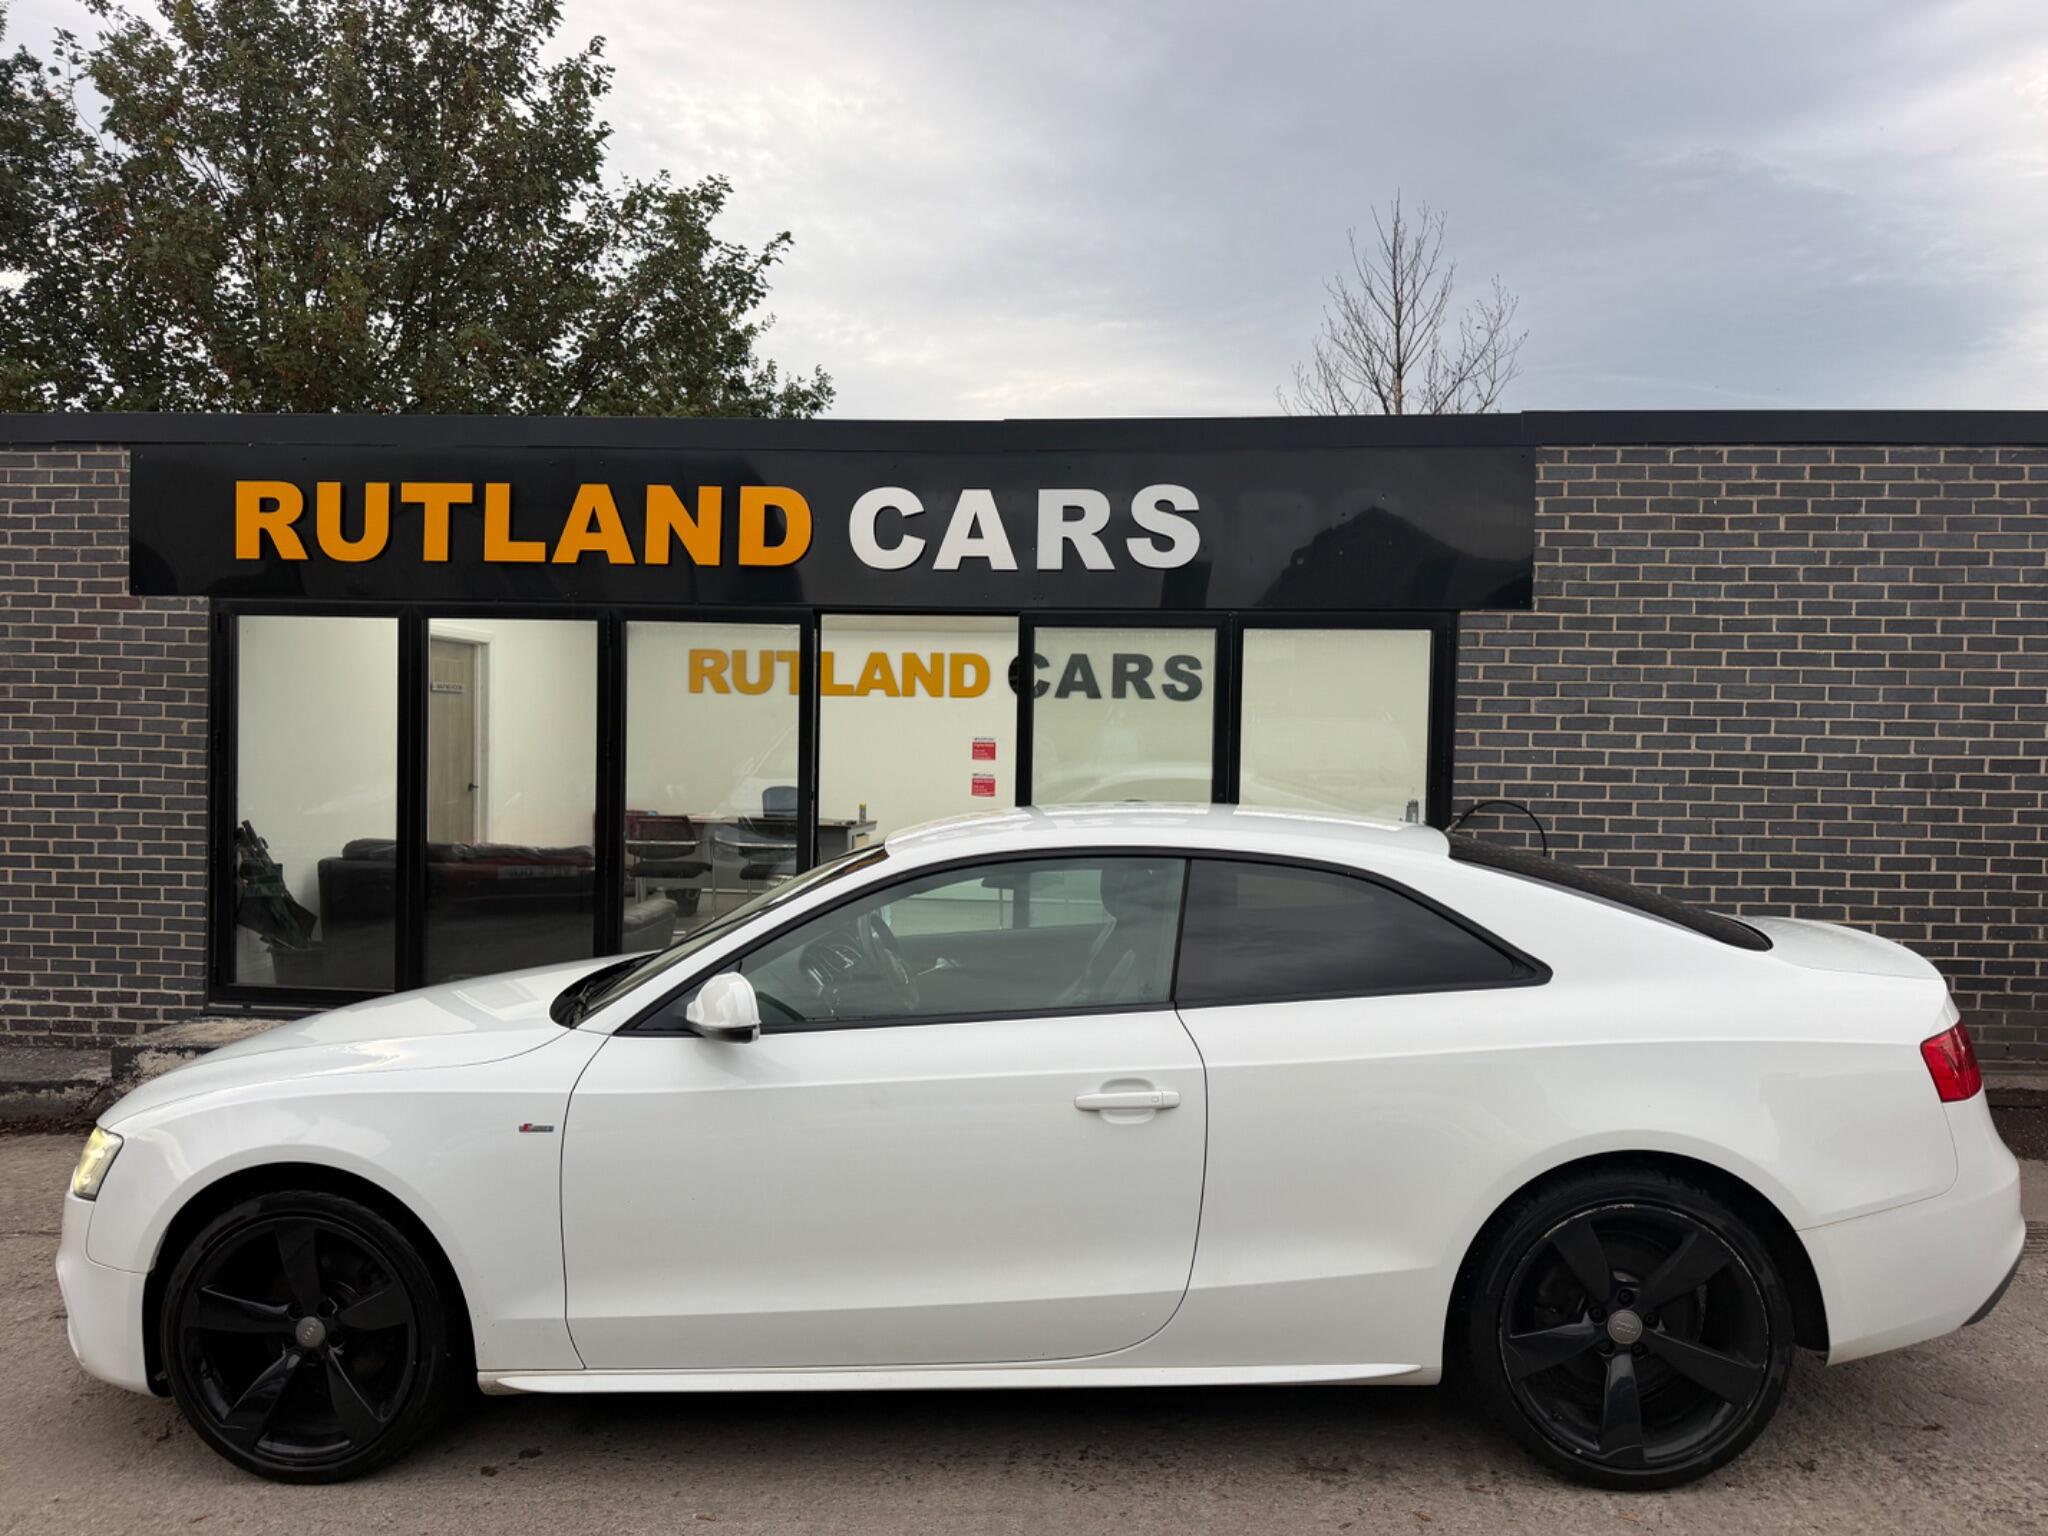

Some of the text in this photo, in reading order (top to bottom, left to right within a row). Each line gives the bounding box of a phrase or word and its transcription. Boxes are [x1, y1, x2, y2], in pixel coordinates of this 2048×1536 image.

[235, 480, 1201, 571] RUTLAND CARS
[688, 648, 1204, 702] RUTLAND CARS
